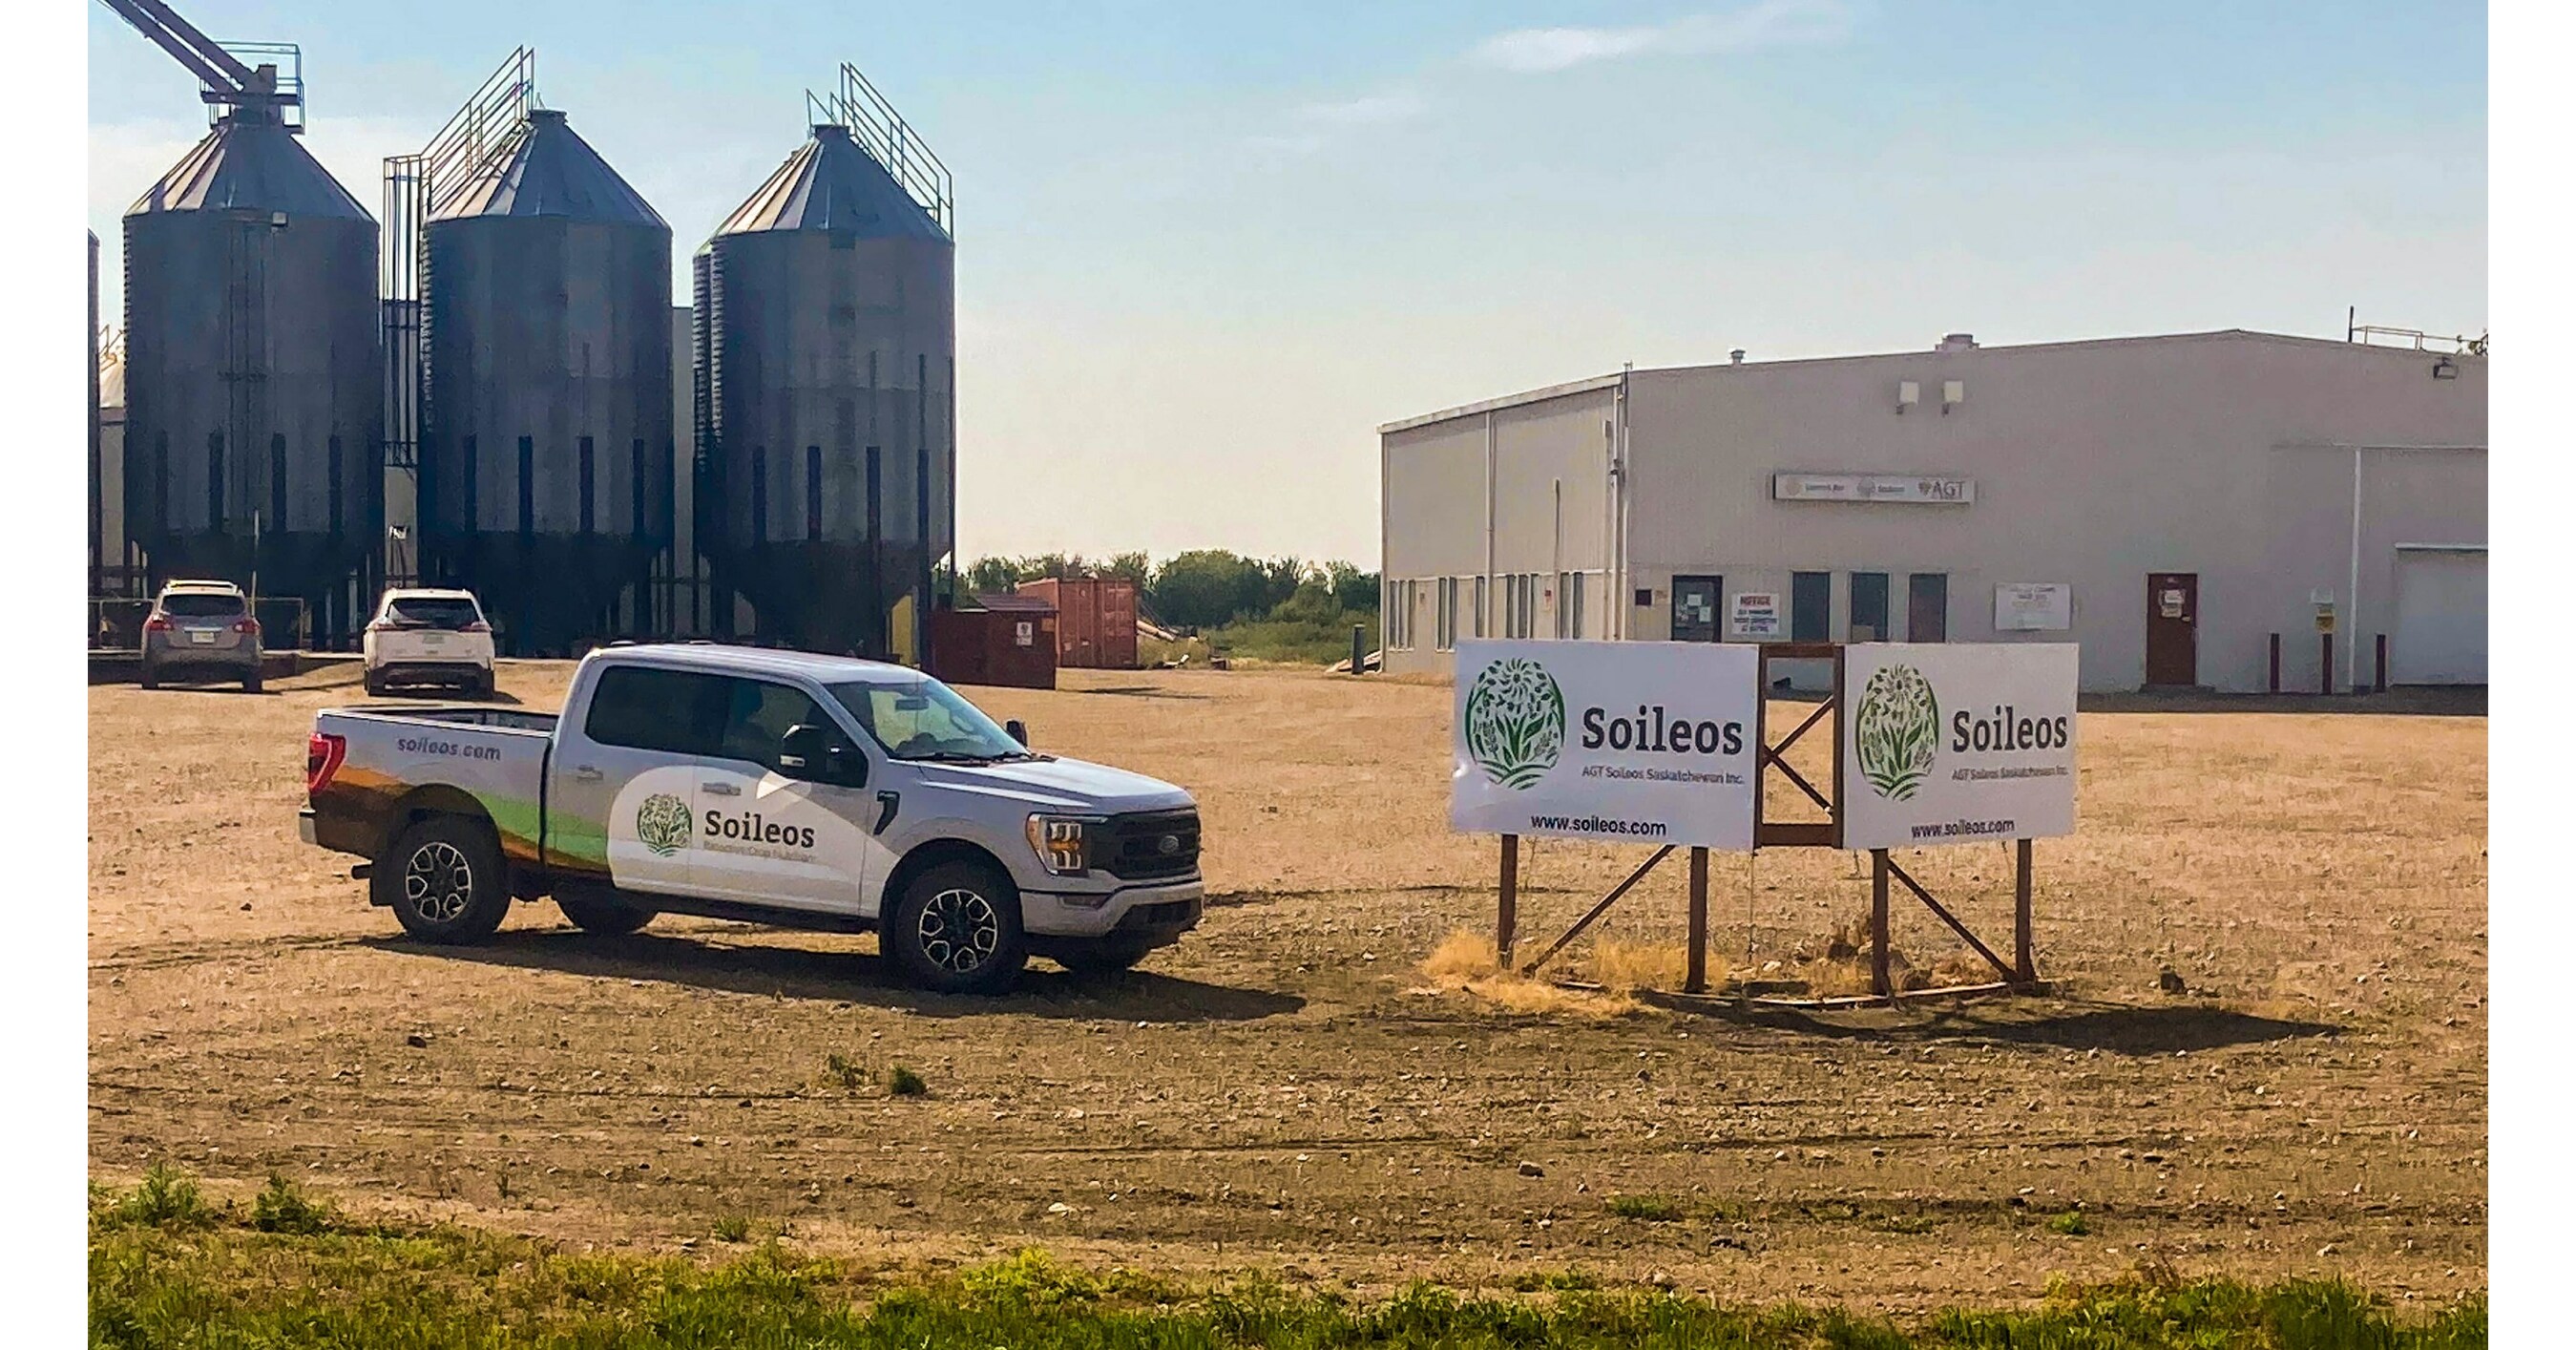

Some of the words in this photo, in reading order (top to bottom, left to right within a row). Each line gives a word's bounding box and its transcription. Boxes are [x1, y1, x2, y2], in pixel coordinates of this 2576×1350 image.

[1932, 481, 1966, 499] AGT
[1582, 705, 1743, 755] Soileos
[1952, 705, 2068, 752] Soileos
[1581, 765, 1603, 777] AGT
[1605, 767, 1644, 779] Soileos
[1646, 768, 1725, 784] Saskatchewan
[704, 810, 815, 849] Soileos
[1530, 815, 1667, 836] www.soileos.com
[1911, 818, 2016, 838] www.soileos.com
